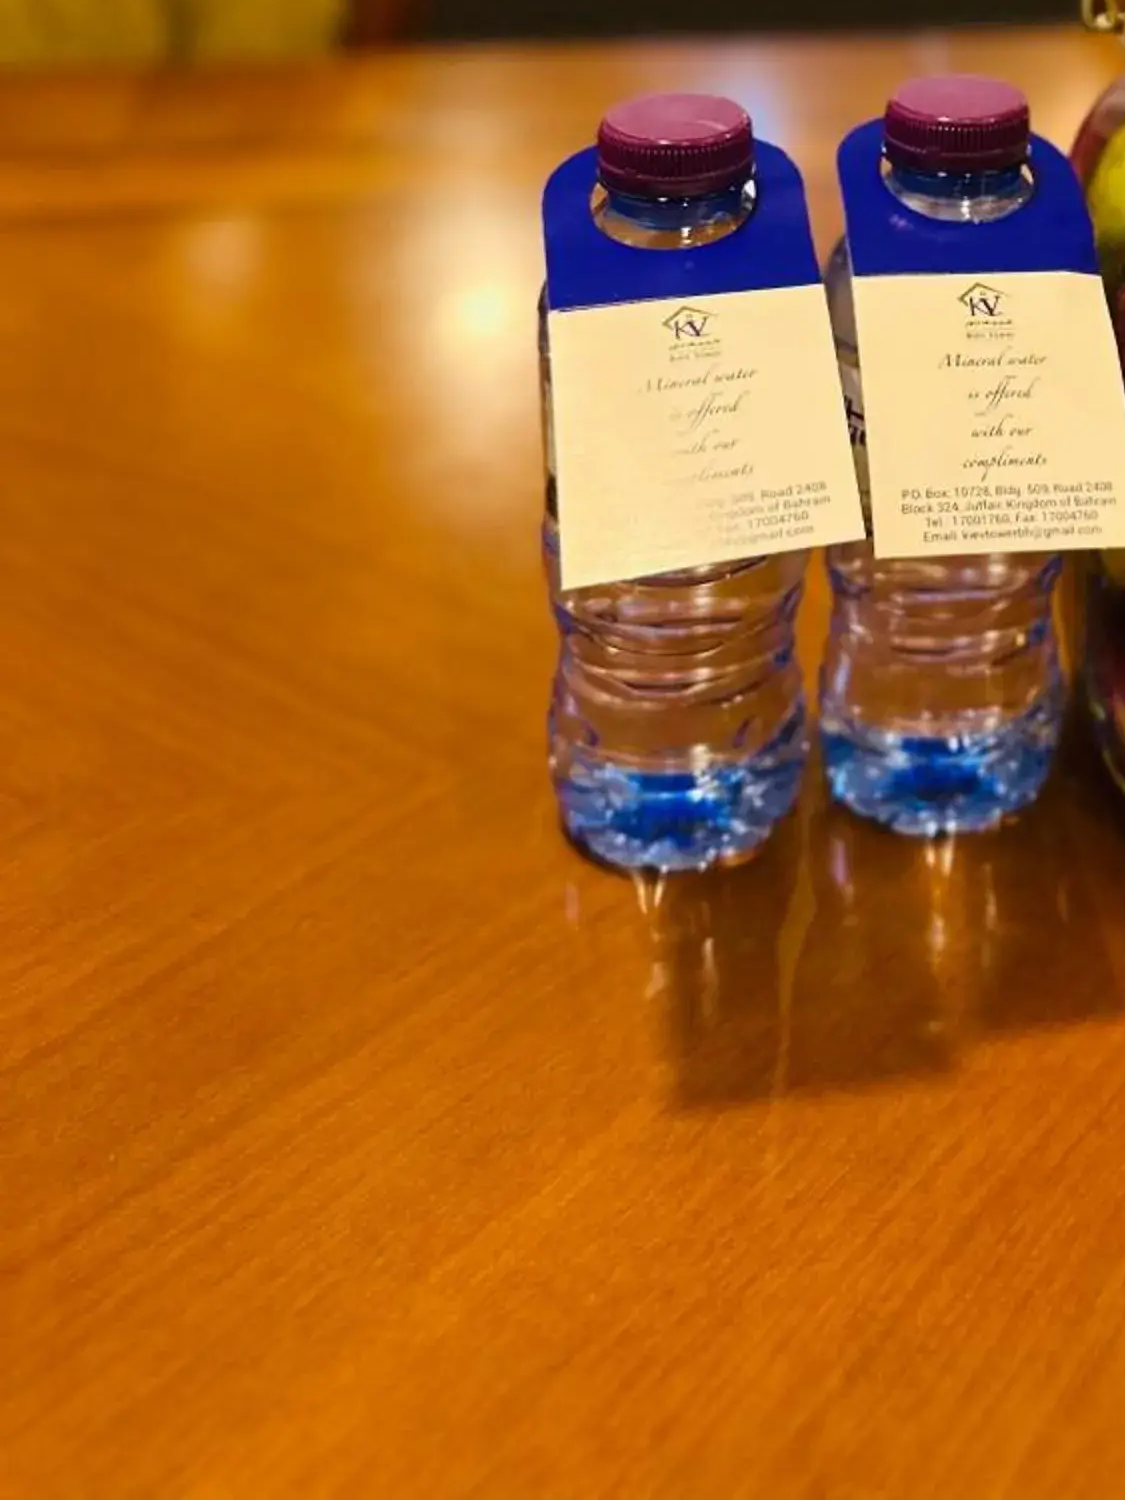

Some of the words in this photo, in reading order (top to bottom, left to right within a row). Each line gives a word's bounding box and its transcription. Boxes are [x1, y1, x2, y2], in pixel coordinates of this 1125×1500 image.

[938, 345, 1013, 370] Mineral
[1006, 352, 1048, 368] water
[636, 362, 721, 394] Mineral
[714, 367, 760, 384] water
[966, 389, 981, 401] is
[974, 374, 1042, 417] offered
[676, 389, 752, 436] offered
[970, 412, 1016, 439] with
[1008, 426, 1036, 439] our
[712, 437, 741, 452] our
[961, 444, 1049, 483] compliments
[760, 485, 793, 500] Road
[796, 480, 828, 495] 2408
[1053, 481, 1083, 494] Road
[767, 499, 780, 513] of
[783, 494, 832, 510] Bahrain
[901, 502, 934, 515] Block
[1006, 496, 1057, 511] Kingdom
[1059, 495, 1071, 508] of
[1073, 494, 1117, 507] Bahrain
[747, 509, 810, 529] 17004760
